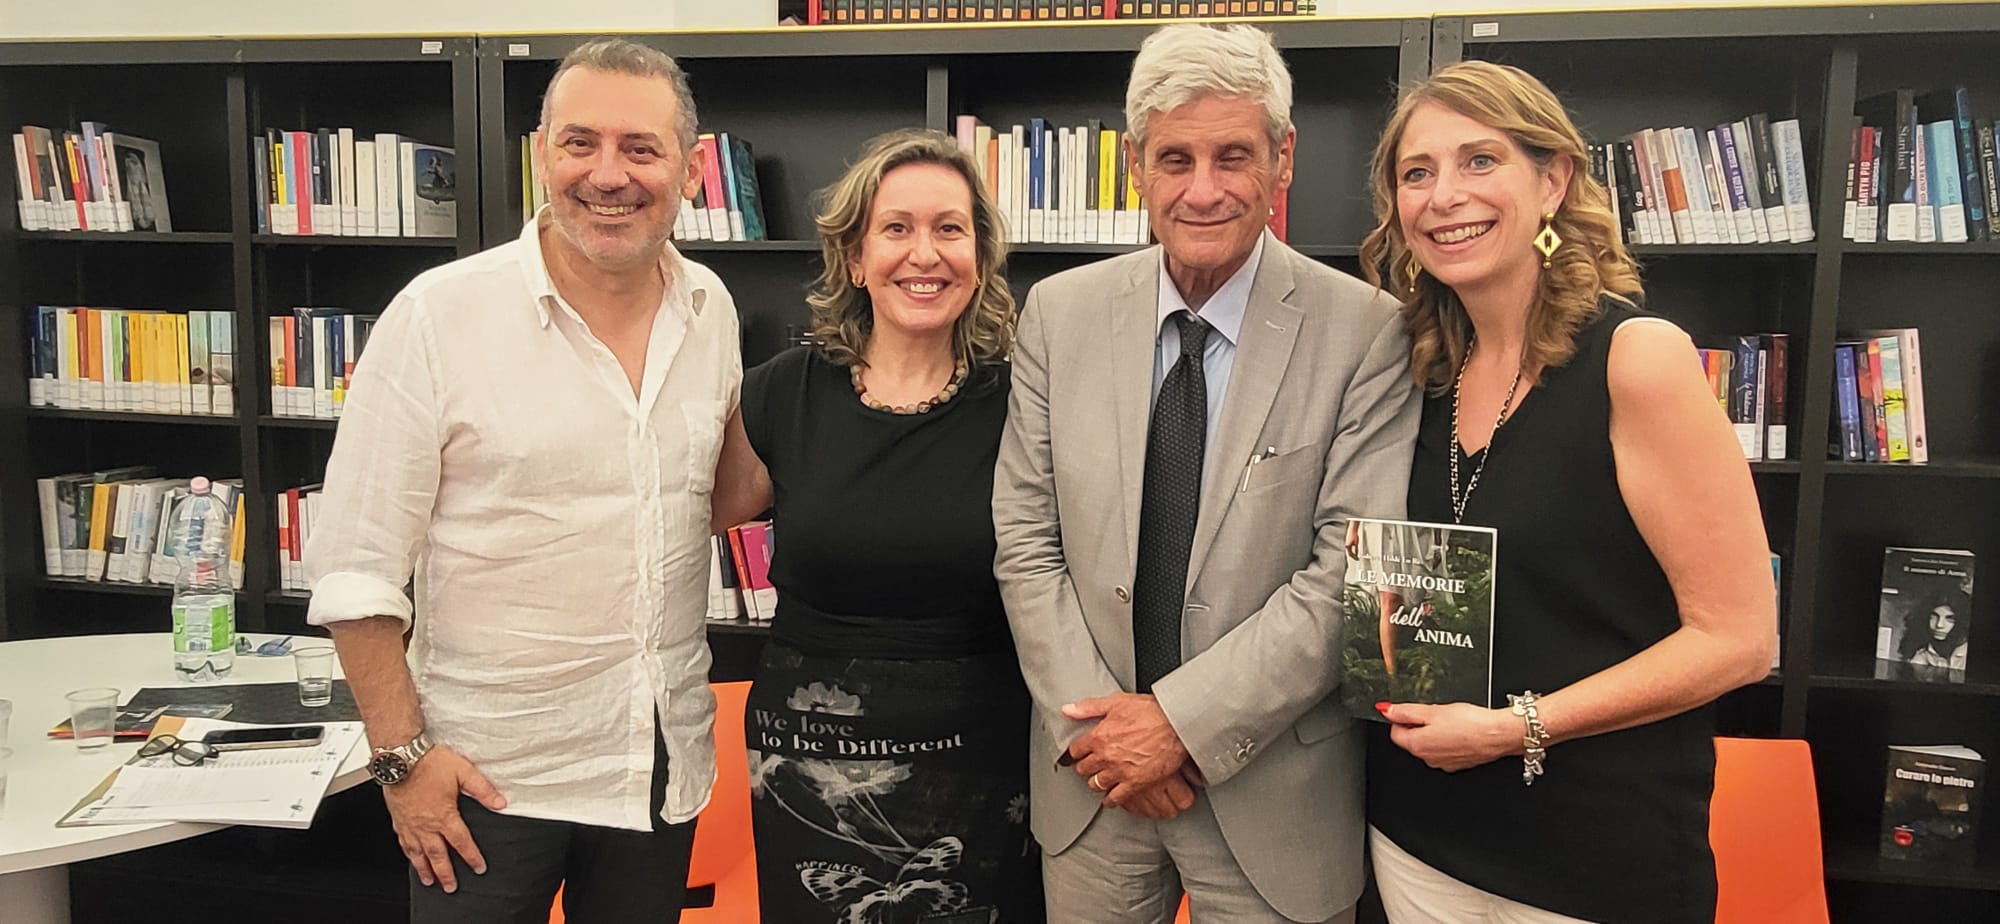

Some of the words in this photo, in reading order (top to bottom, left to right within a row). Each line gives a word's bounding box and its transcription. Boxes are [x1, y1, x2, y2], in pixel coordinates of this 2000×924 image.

[1898, 126, 1909, 170] Stardust
[1358, 569, 1377, 583] LE
[1380, 571, 1466, 593] MEMORIE
[1414, 628, 1474, 648] ANIMA
[755, 709, 788, 731] We
[801, 715, 854, 737] love
[762, 731, 782, 748] to
[794, 734, 824, 751] be
[838, 733, 964, 755] Different
[795, 860, 866, 875] HAPPINESS
